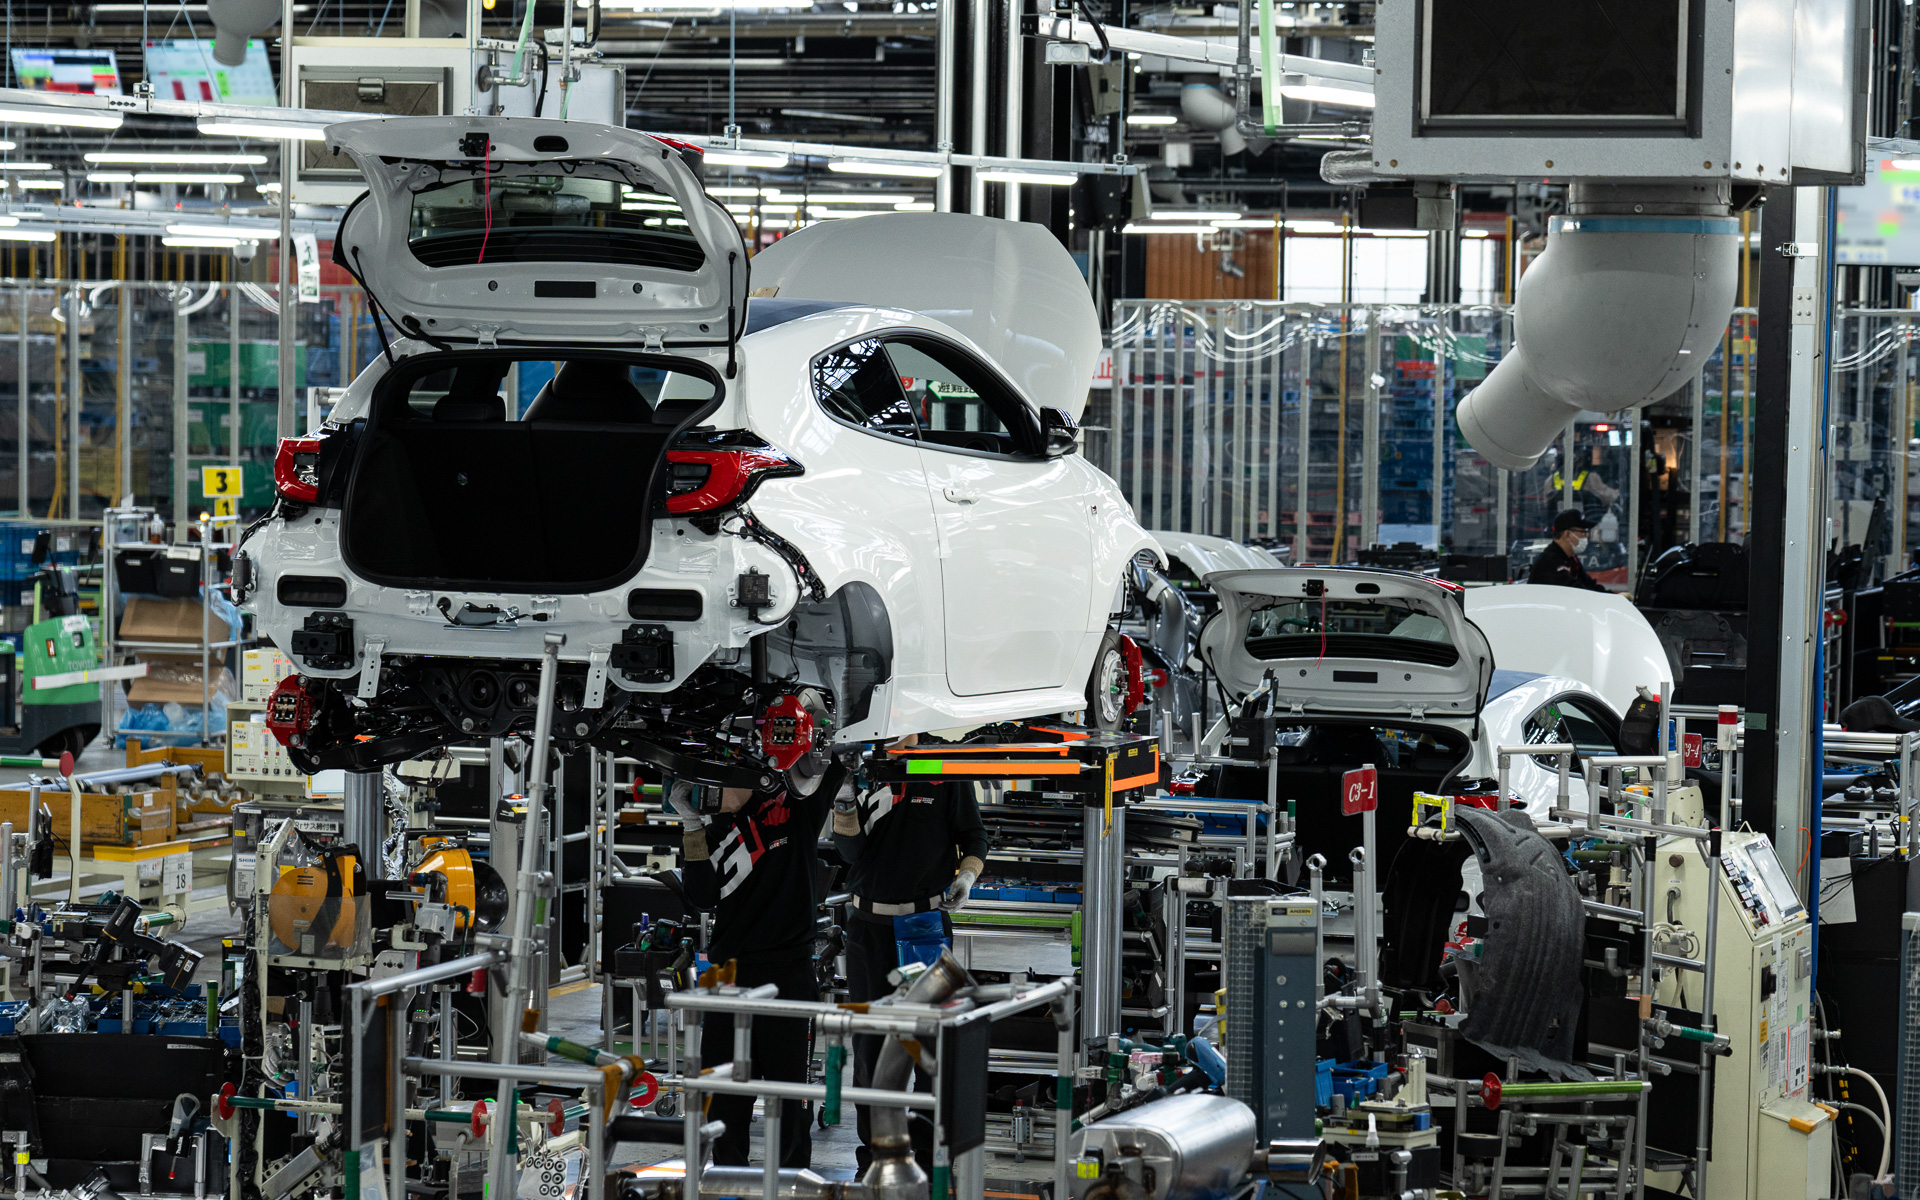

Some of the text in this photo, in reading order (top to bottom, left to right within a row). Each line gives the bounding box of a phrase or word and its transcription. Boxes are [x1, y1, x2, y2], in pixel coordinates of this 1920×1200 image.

[1092, 356, 1113, 380] 止
[216, 471, 228, 493] 3
[68, 659, 95, 672] TOYOTA
[1684, 743, 1700, 758] 3-4
[1348, 781, 1375, 802] C3-1
[176, 873, 186, 890] 18
